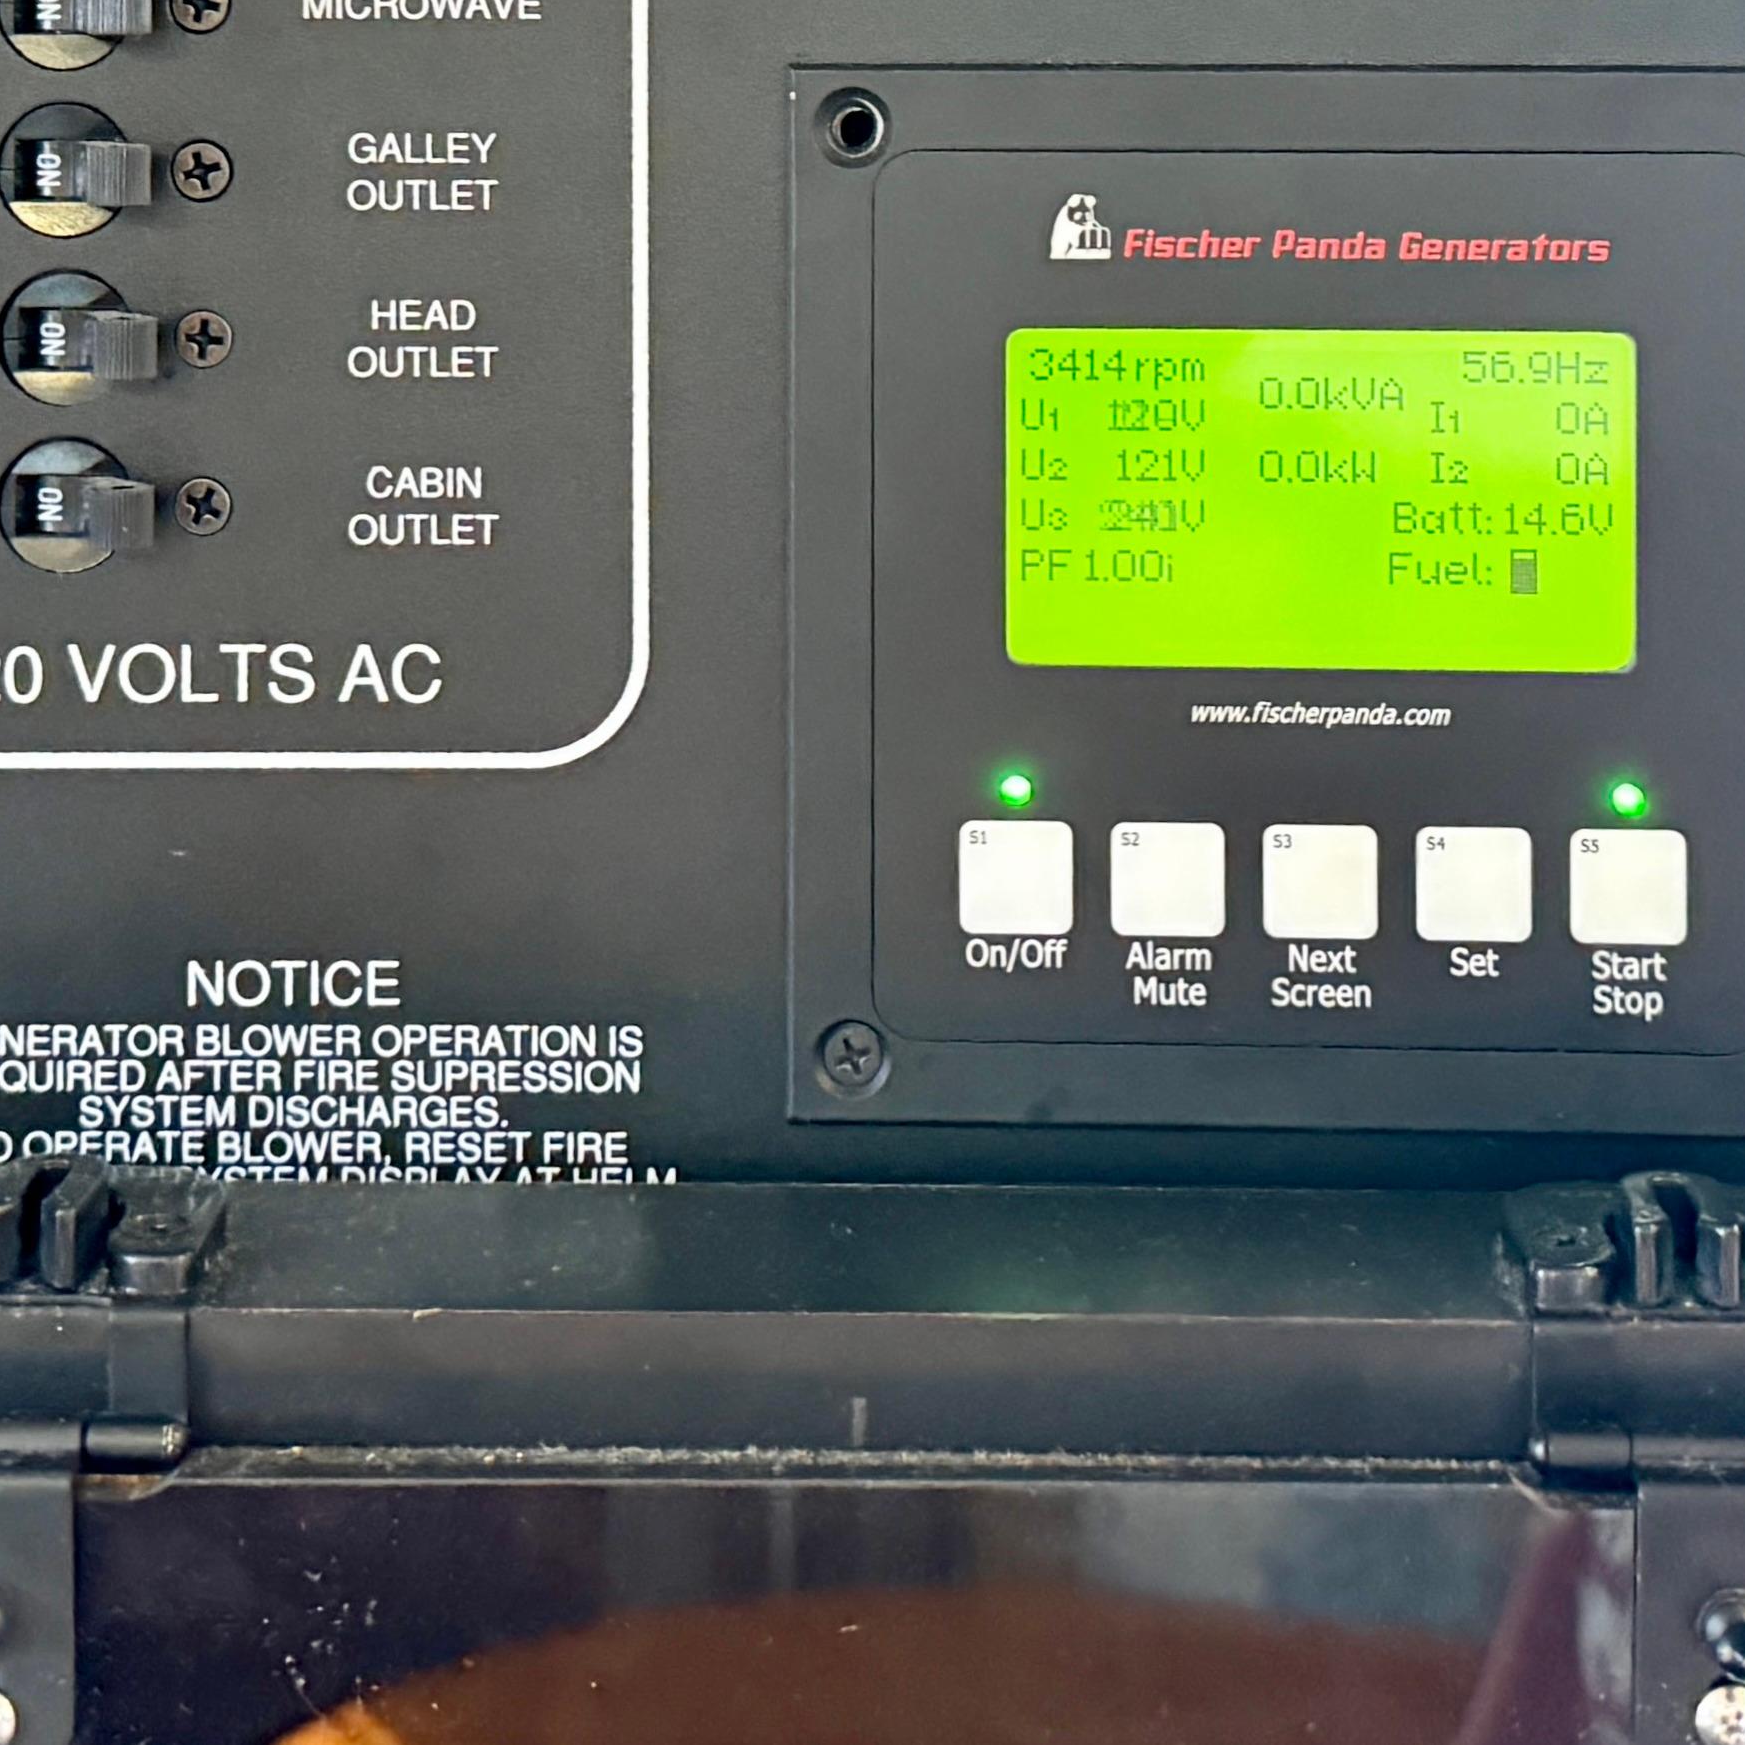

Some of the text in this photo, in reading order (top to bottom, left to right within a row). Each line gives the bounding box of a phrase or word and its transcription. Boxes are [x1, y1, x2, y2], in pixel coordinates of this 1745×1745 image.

[347, 132, 497, 164] GALLEY
[36, 153, 63, 187] ON
[346, 179, 499, 211] OUTLET
[1123, 228, 1611, 262] Fischer Panda Generators
[371, 299, 476, 331] HEAD
[41, 321, 66, 356] ON
[347, 345, 500, 378] OUTLET
[1117, 449, 1205, 481] 121V
[366, 465, 482, 499] CABIN
[38, 487, 63, 521] ON
[348, 513, 500, 546] OUTLET
[1389, 552, 1492, 585] Fuel:
[67, 643, 316, 704] VOLTS
[338, 643, 442, 704] AC
[1191, 701, 1452, 729] www.fischerpanda.com
[968, 830, 988, 846] S1
[1121, 832, 1141, 846] S2
[1272, 834, 1293, 849] S3
[1425, 836, 1446, 851] S4
[1580, 839, 1600, 854] S5
[965, 938, 1068, 973] On/Off
[1126, 941, 1211, 970] Alarm
[1289, 944, 1356, 973] Next
[1450, 947, 1499, 977] Set
[1592, 950, 1666, 981] Start
[187, 959, 401, 1008] NOTICE
[1133, 975, 1207, 1007] Mute
[1271, 976, 1372, 1008] Screen
[1593, 984, 1664, 1022] Stop
[195, 1023, 361, 1058] BLOWER
[371, 1024, 597, 1058] OPERATION
[608, 1025, 644, 1058] IS
[156, 1059, 281, 1092] AFTER
[294, 1059, 379, 1092] FIRE
[390, 1059, 641, 1094] SUPRESSION
[80, 1095, 508, 1128] SYSTEM DISCHARGES.
[216, 1130, 391, 1166] BLOWER,
[405, 1131, 532, 1164] RESET
[543, 1131, 628, 1165] FIRE
